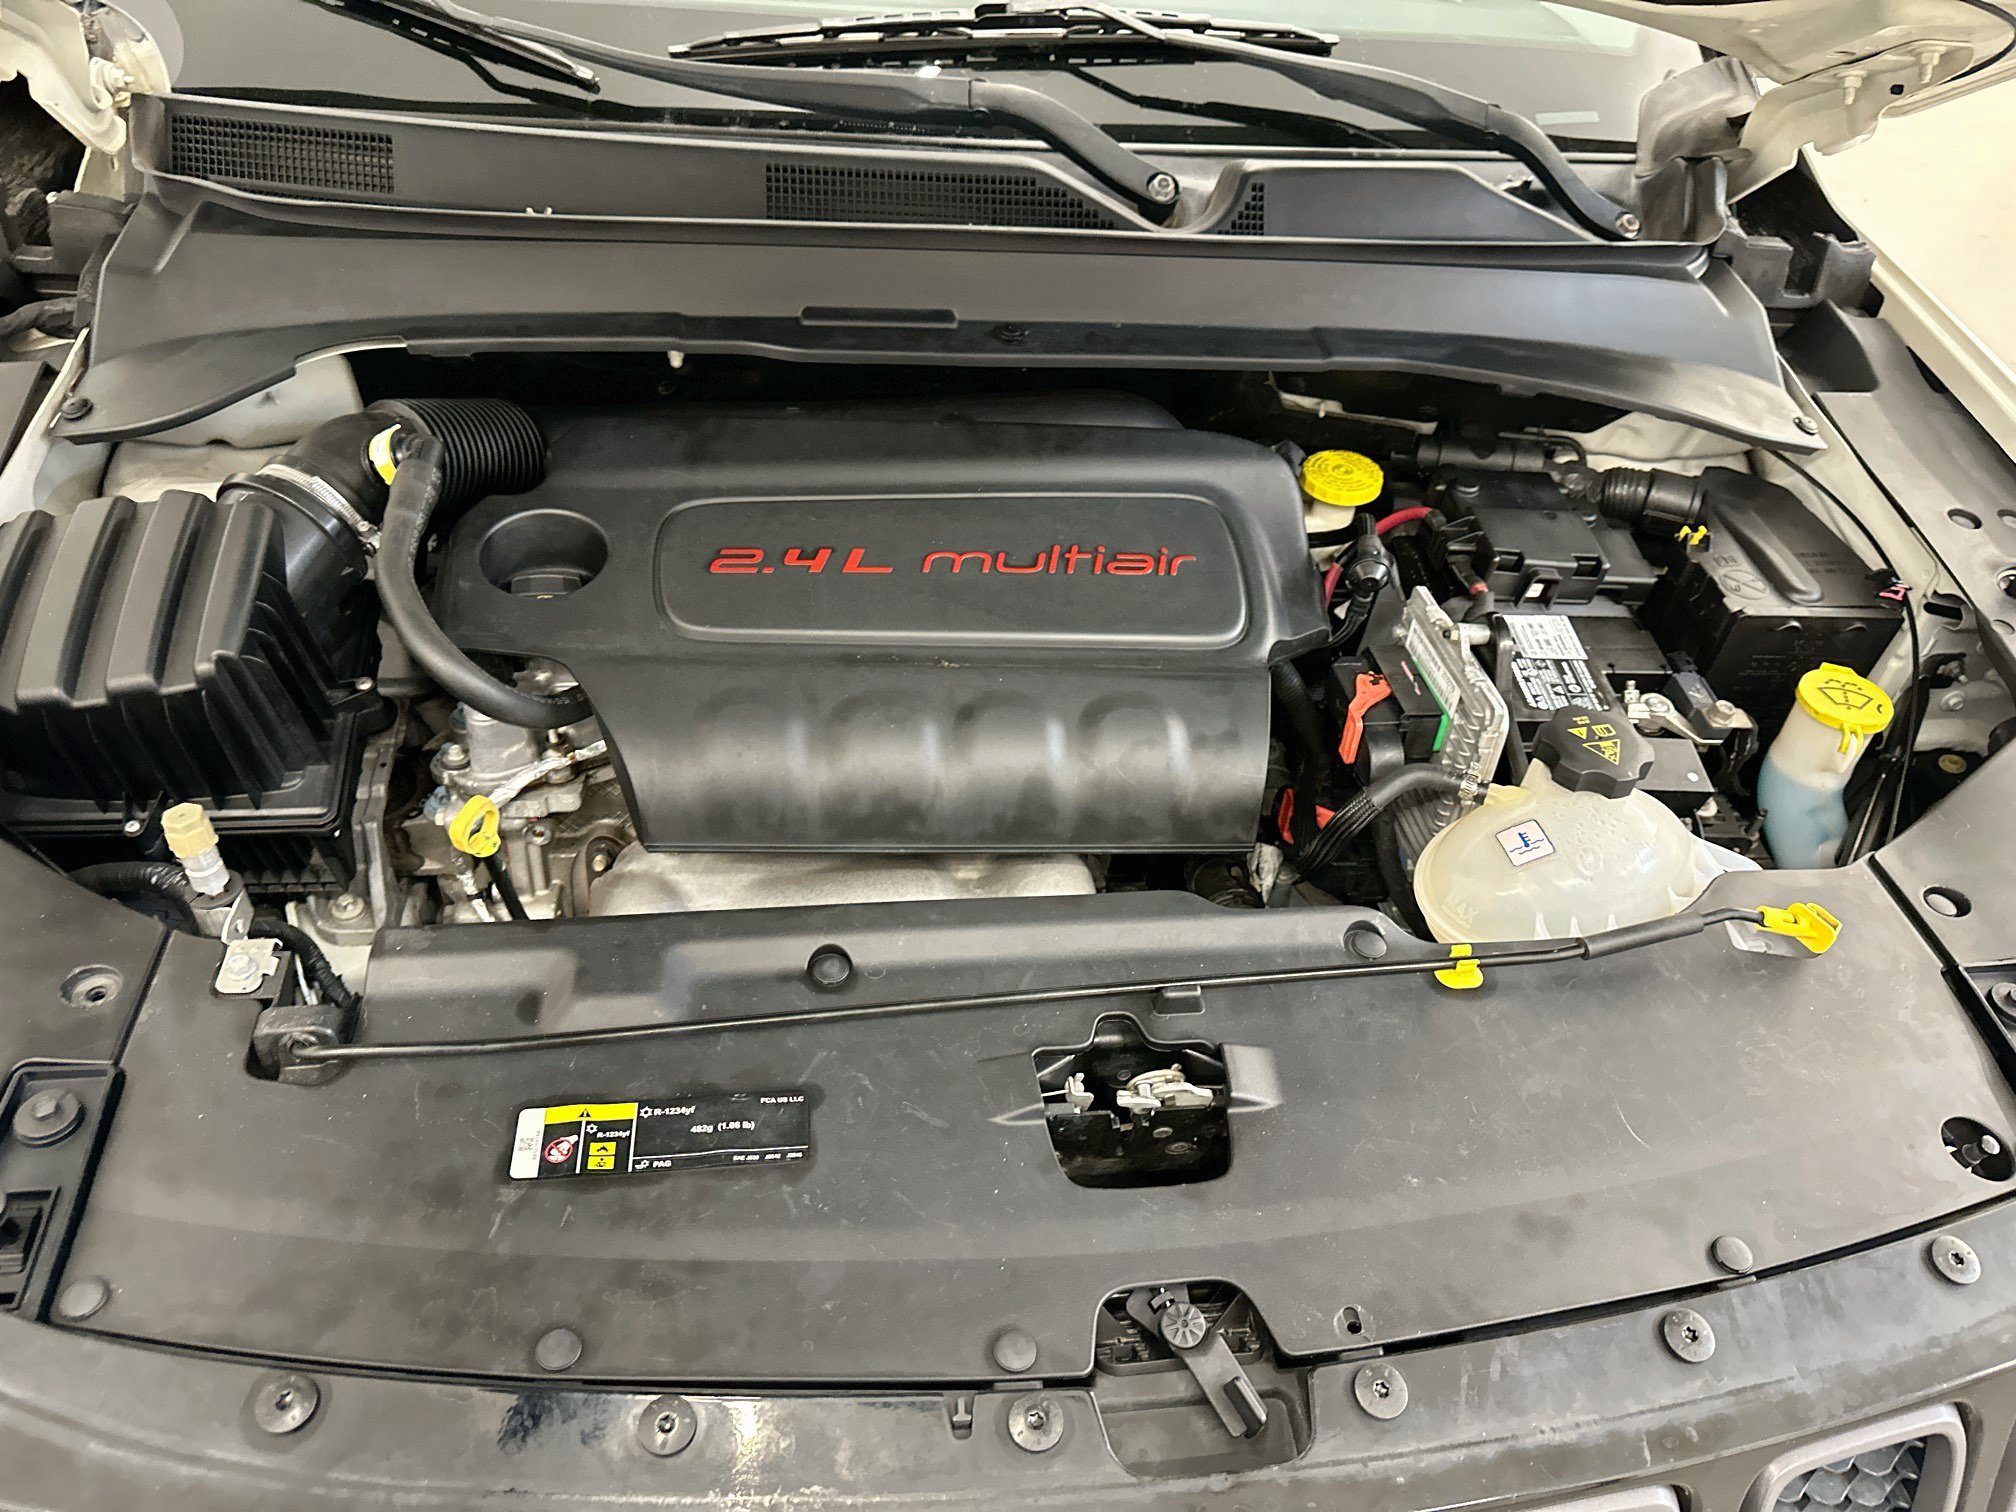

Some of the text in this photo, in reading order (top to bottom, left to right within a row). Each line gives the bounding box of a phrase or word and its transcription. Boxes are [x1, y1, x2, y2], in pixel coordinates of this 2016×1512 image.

[921, 543, 1198, 576] multiair
[653, 1105, 697, 1117] R-1234yf
[596, 1130, 631, 1139] R-1234yf
[652, 1160, 672, 1168] PAG
